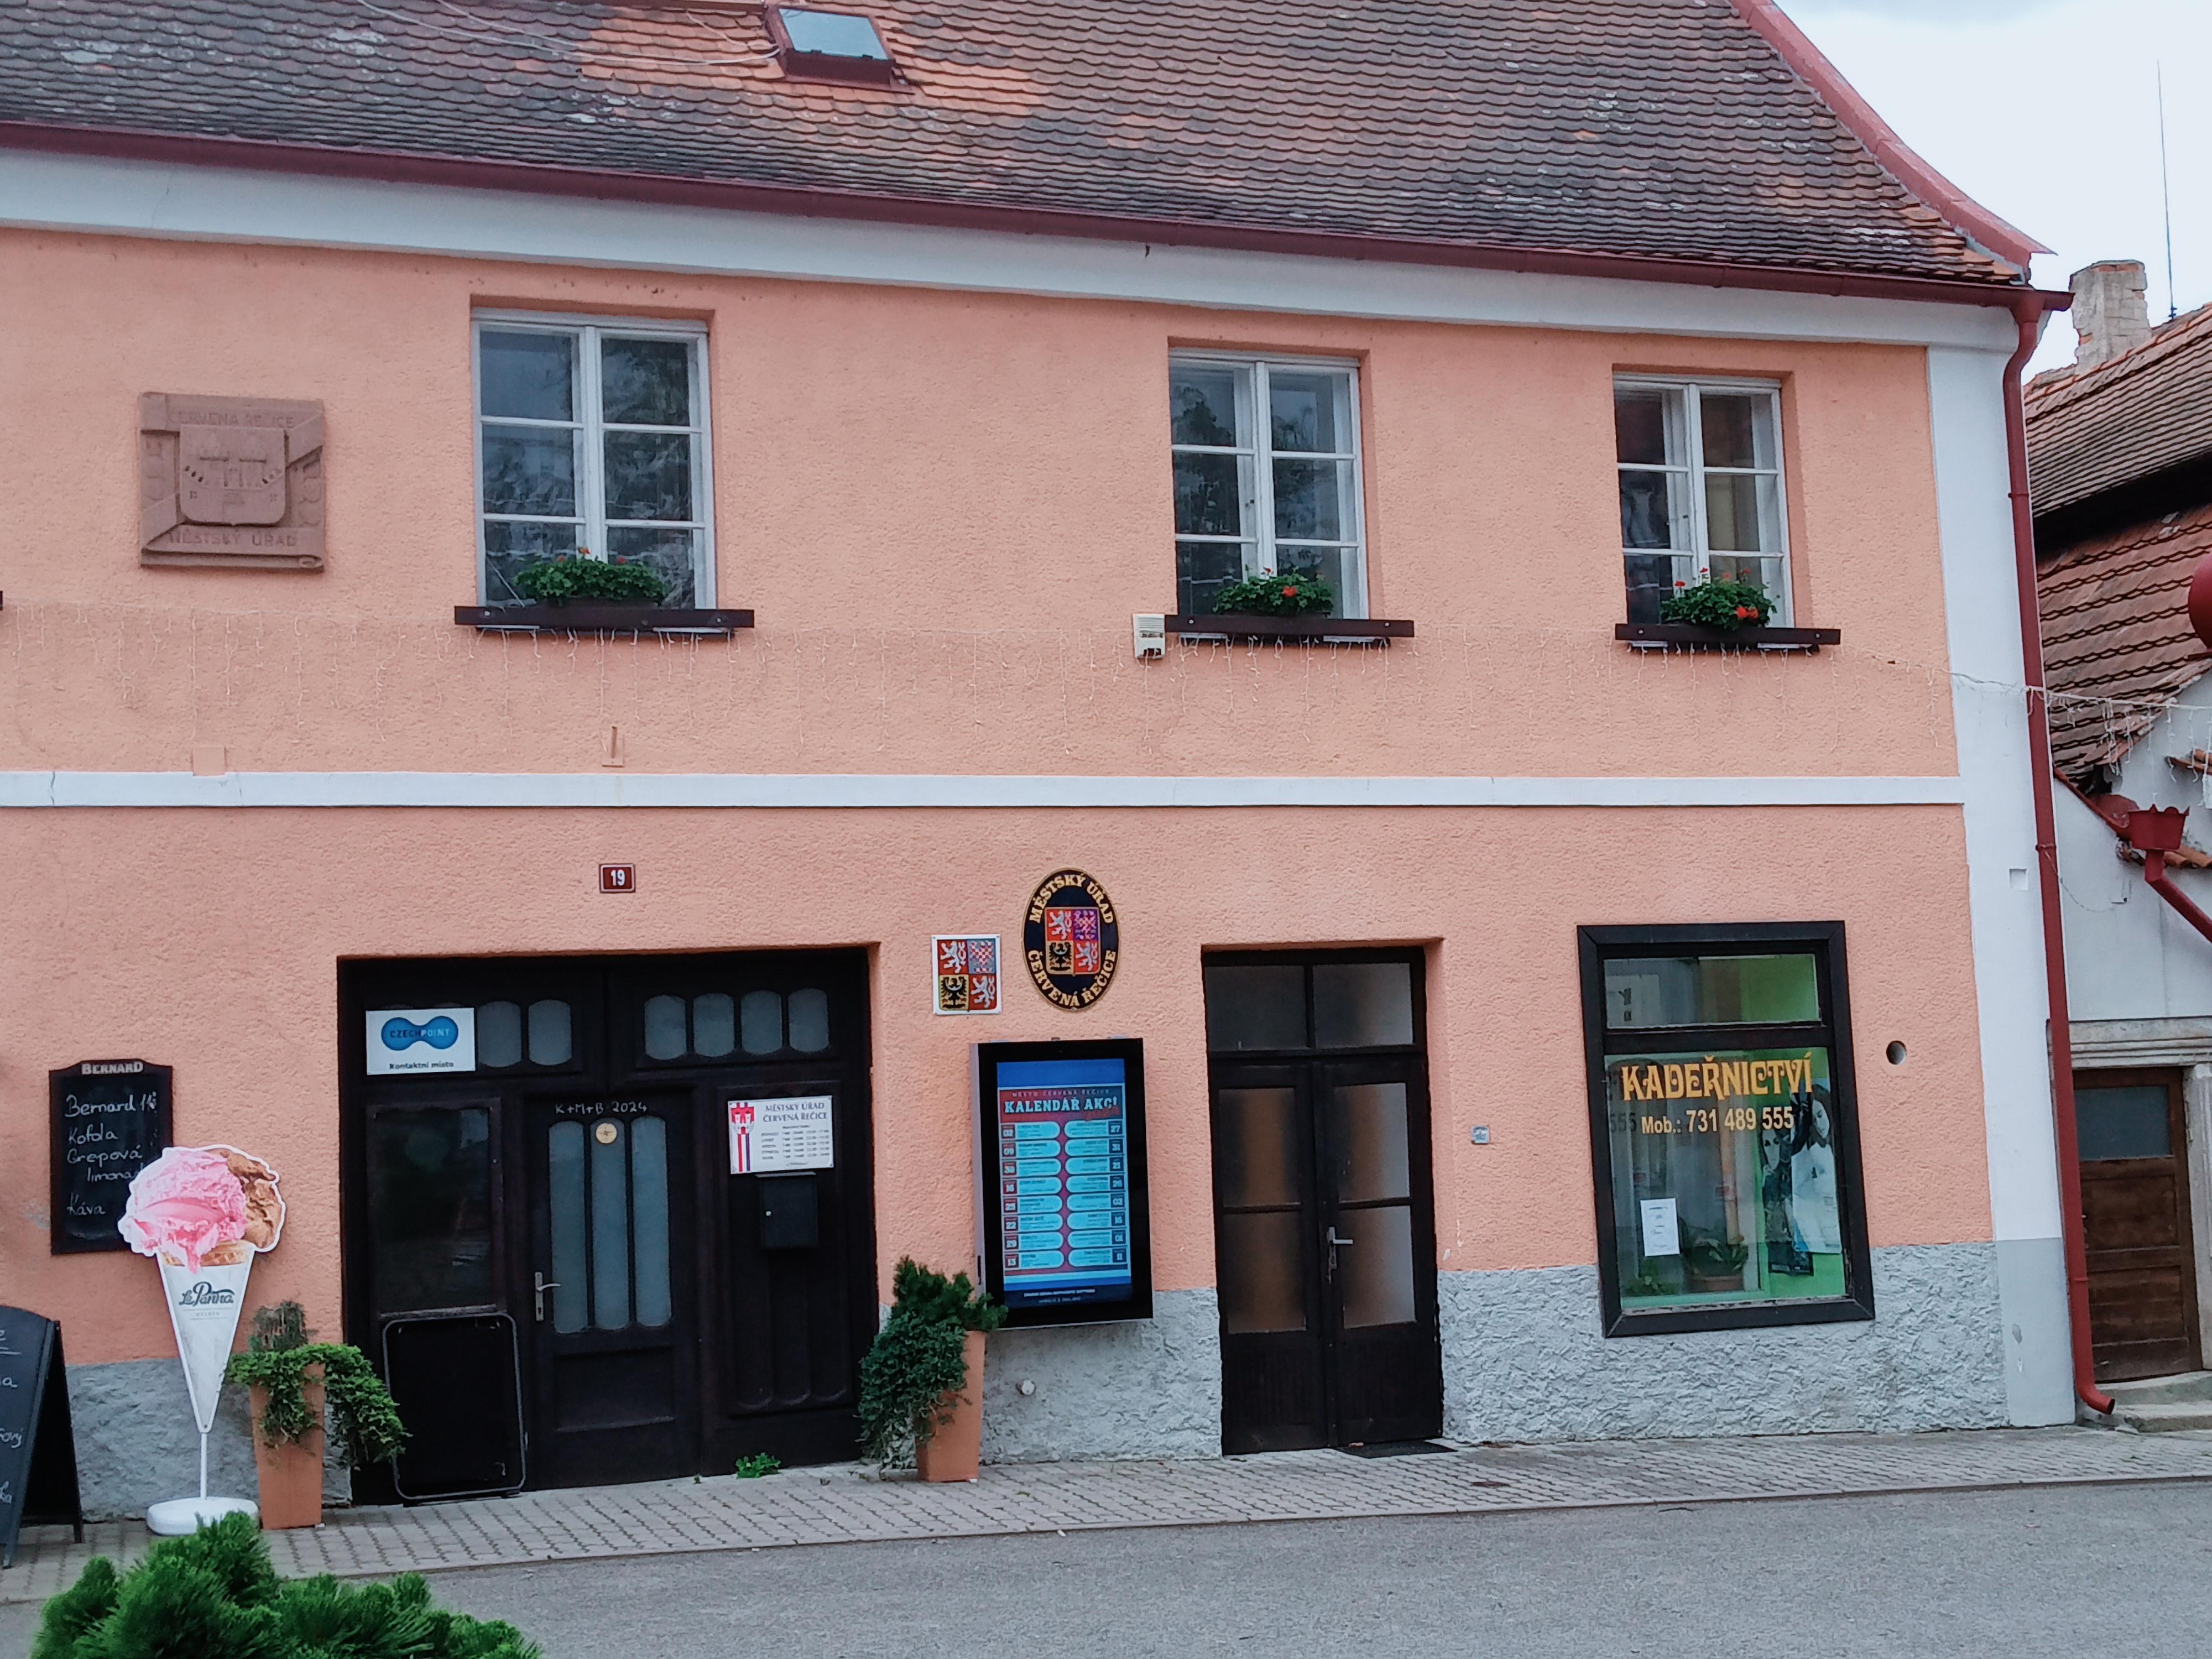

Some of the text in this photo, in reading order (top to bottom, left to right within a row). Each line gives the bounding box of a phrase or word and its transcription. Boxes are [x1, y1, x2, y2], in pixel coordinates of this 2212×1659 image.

[611, 869, 625, 886] 19
[1029, 873, 1114, 923] MĚSTSKÝ ÚŘAD
[1028, 950, 1116, 1006] ČERVENÁ ŘEČICE
[82, 1061, 144, 1075] BERNARD
[389, 1060, 454, 1070] Kontaktní místo
[1621, 1051, 1813, 1101] KADEŘNICTVÍ
[65, 1094, 136, 1118] Bernard
[556, 1100, 648, 1115] K+M+B 2024
[765, 1102, 825, 1113] MĚSTSKÝ ÚŘAD
[1004, 1097, 1080, 1114] KALENDÁŘ
[763, 1112, 828, 1122] ČERVENÁ ŘEČICE
[1641, 1106, 1794, 1134] Mob.: 731 489 555
[68, 1123, 119, 1145] Kofola
[67, 1145, 143, 1168] Grepová
[66, 1192, 106, 1216] Káva
[192, 1281, 235, 1307] Panna
